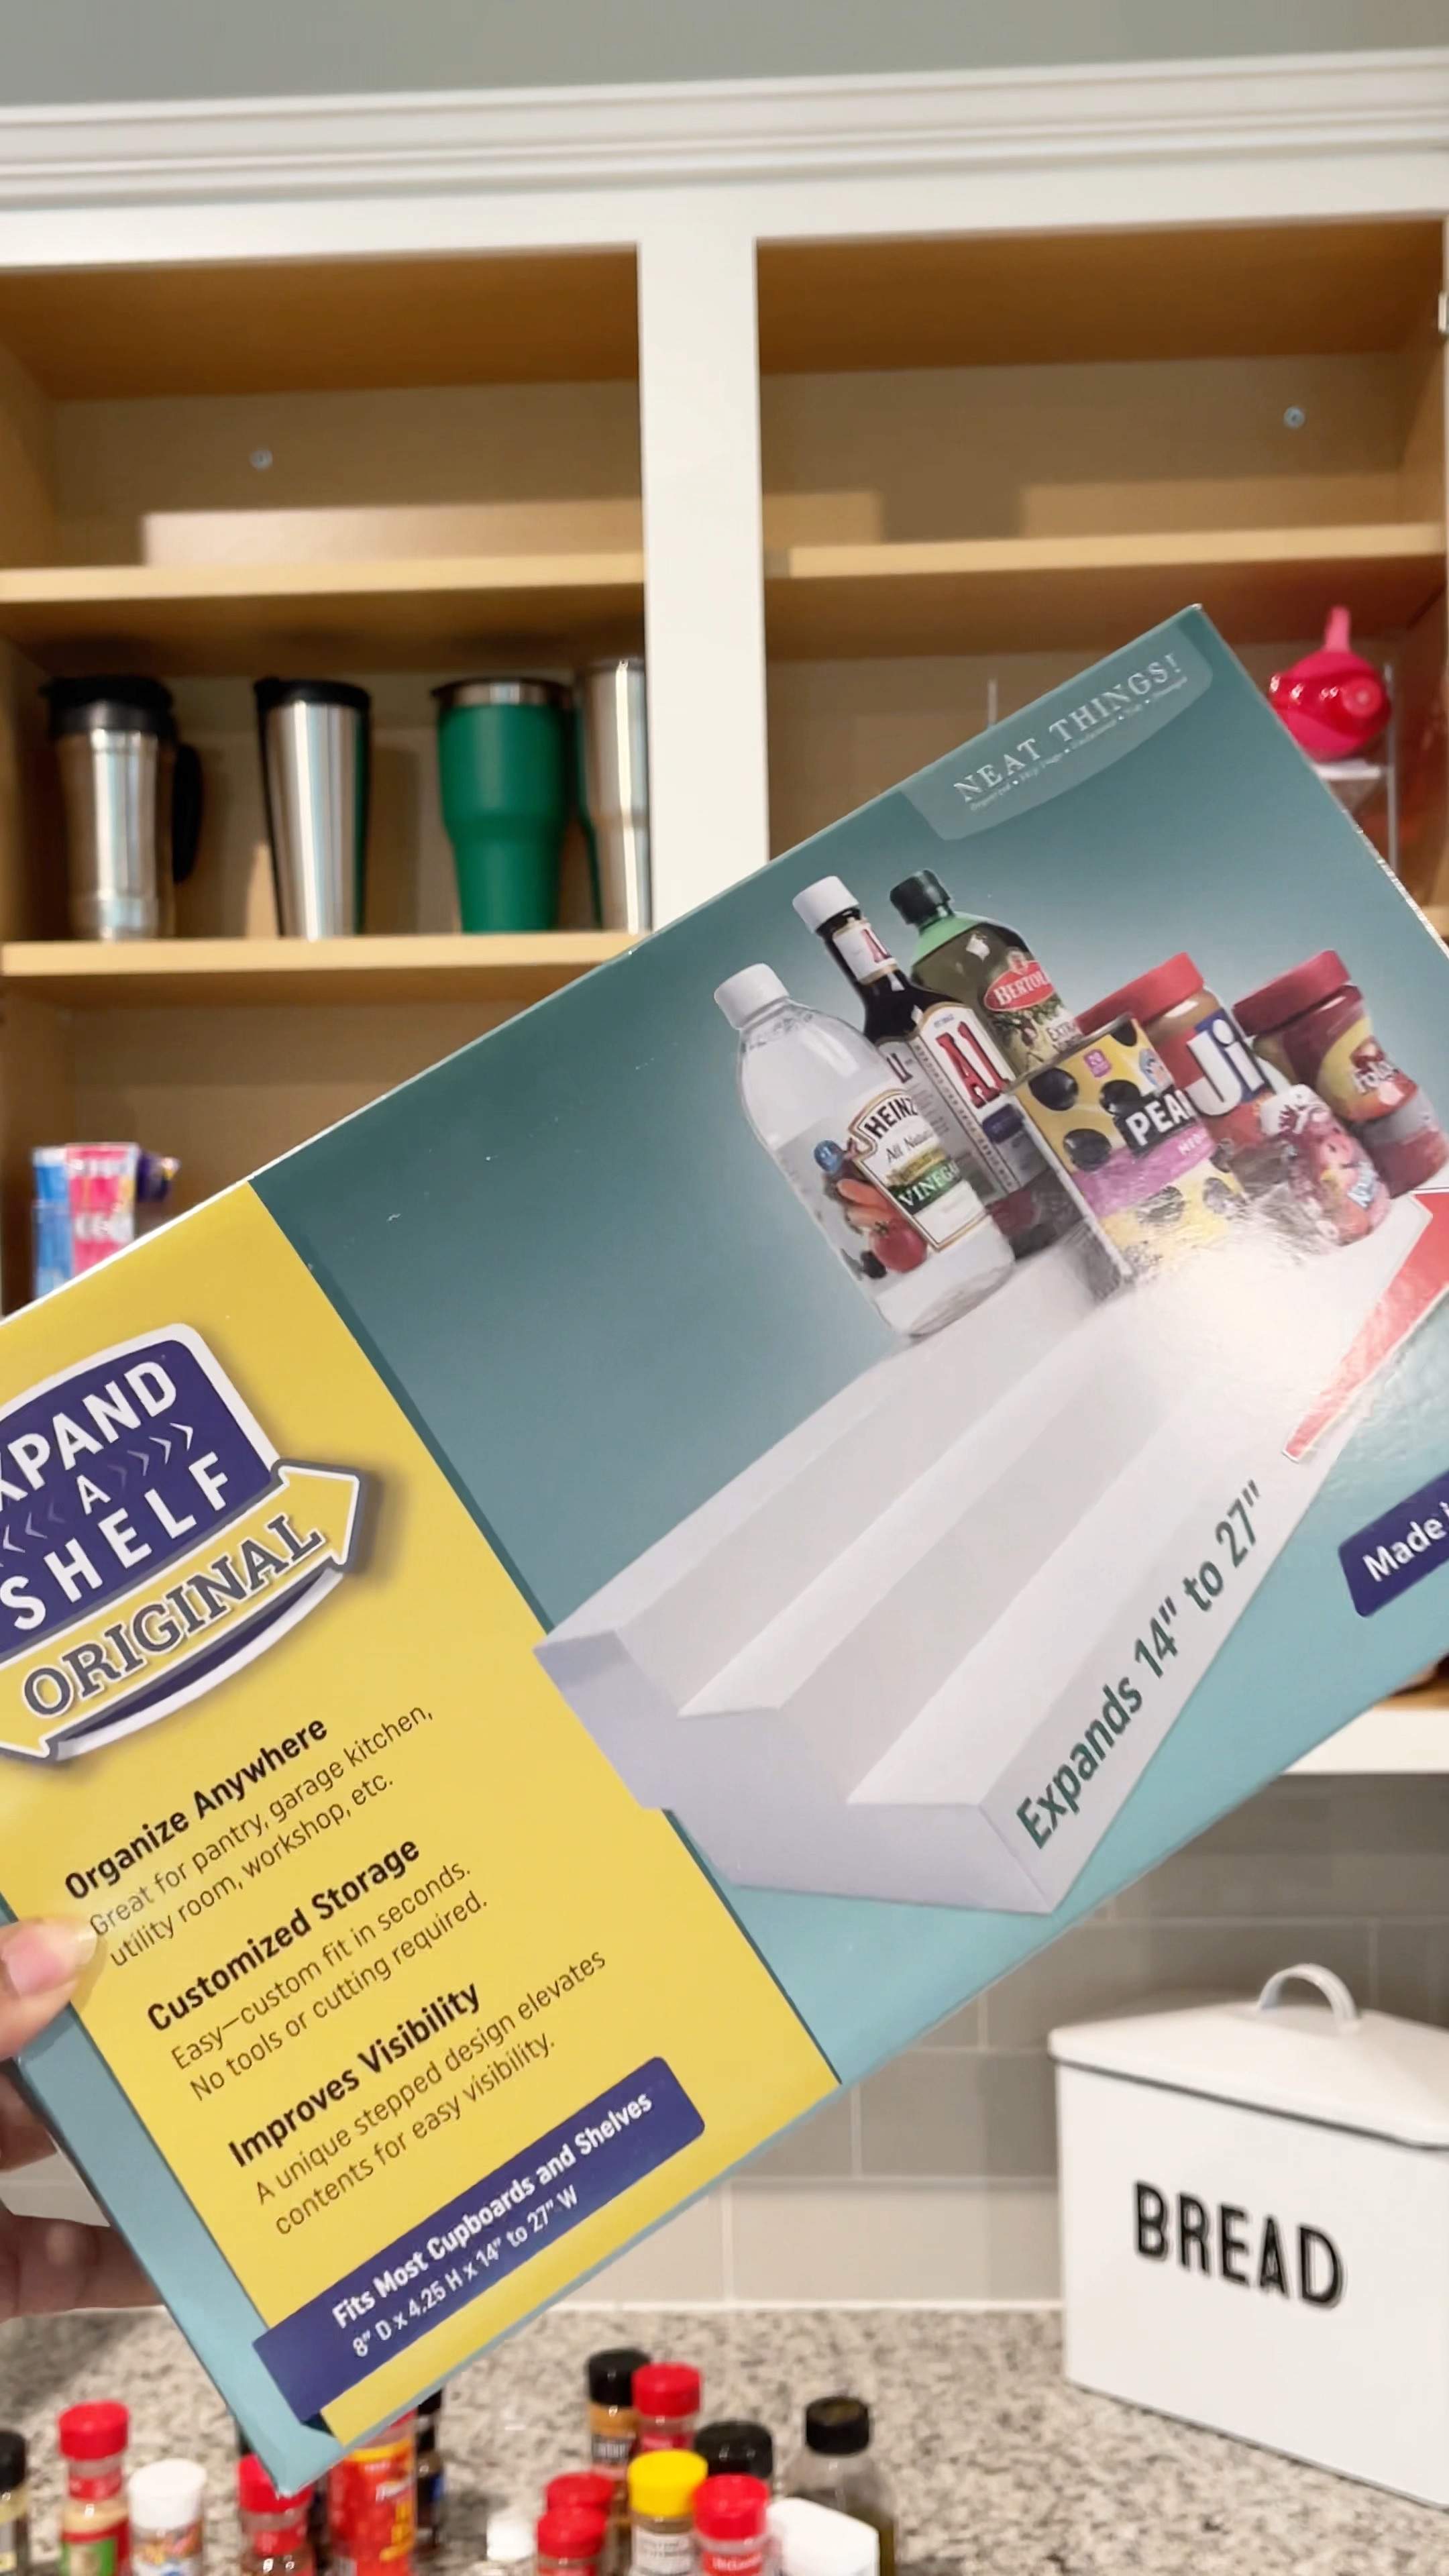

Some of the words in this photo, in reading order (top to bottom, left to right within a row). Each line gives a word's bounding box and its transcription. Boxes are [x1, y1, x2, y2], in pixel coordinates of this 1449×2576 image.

[954, 738, 1040, 803] NEAT
[1049, 652, 1181, 742] THINGS!
[864, 1097, 918, 1139] HEINZ
[1, 1451, 229, 1630] SHELF
[76, 1474, 111, 1515] A
[1362, 1518, 1447, 1582] Made
[24, 1515, 323, 1715] ORIGINAL
[1016, 1676, 1143, 1849] Expands
[1134, 1597, 1179, 1679] 14"
[1182, 1560, 1225, 1613] to
[1215, 1479, 1261, 1568] 27"
[65, 1811, 190, 1900] Organize
[192, 1719, 328, 1820] Anywhere
[89, 1886, 154, 1936] Great
[154, 1865, 187, 1896] for
[192, 1813, 269, 1874] pantry,
[268, 1762, 345, 1823] garage
[343, 1707, 434, 1768] kitchen,
[110, 1912, 175, 1967] utility
[177, 1875, 244, 1923] room,
[241, 1802, 352, 1879] workshop,
[351, 1773, 394, 1806] etc.
[148, 1908, 311, 2032] Customized
[311, 1837, 421, 1921] Storage
[189, 2071, 225, 2102] No
[225, 2029, 284, 2076] tools
[285, 2012, 309, 2039] or
[312, 1955, 392, 2020] cutting
[392, 1891, 488, 1967] required.
[323, 1937, 353, 1963] fit
[352, 1921, 376, 1947] in
[376, 1858, 472, 1933] seconds.
[228, 2066, 360, 2167] Improves
[358, 1982, 482, 2076] Visibility
[254, 2180, 272, 2205] A
[274, 2125, 352, 2192] unique
[353, 2063, 443, 2137] stepped
[445, 2013, 516, 2073] design
[518, 1948, 606, 2020] elevates
[275, 2158, 376, 2236] contents
[373, 2132, 409, 2169] for
[409, 2093, 463, 2144] easy
[462, 2033, 555, 2104] visibility.
[332, 2289, 375, 2328] Fits
[372, 2251, 429, 2298] Most
[427, 2174, 535, 2261] Cupboards
[535, 2144, 577, 2186] and
[575, 2094, 653, 2156] Shelves
[352, 2332, 372, 2358] 8"
[375, 2321, 392, 2342] D
[392, 2312, 409, 2330] x
[408, 2279, 446, 2319] 4.25
[445, 2269, 464, 2292] H
[465, 2261, 478, 2279] x
[476, 2237, 502, 2269] 14"
[506, 2226, 528, 2247] to
[527, 2199, 555, 2234] 27"
[556, 2184, 578, 2209] W
[1134, 2180, 1346, 2310] BREAD
